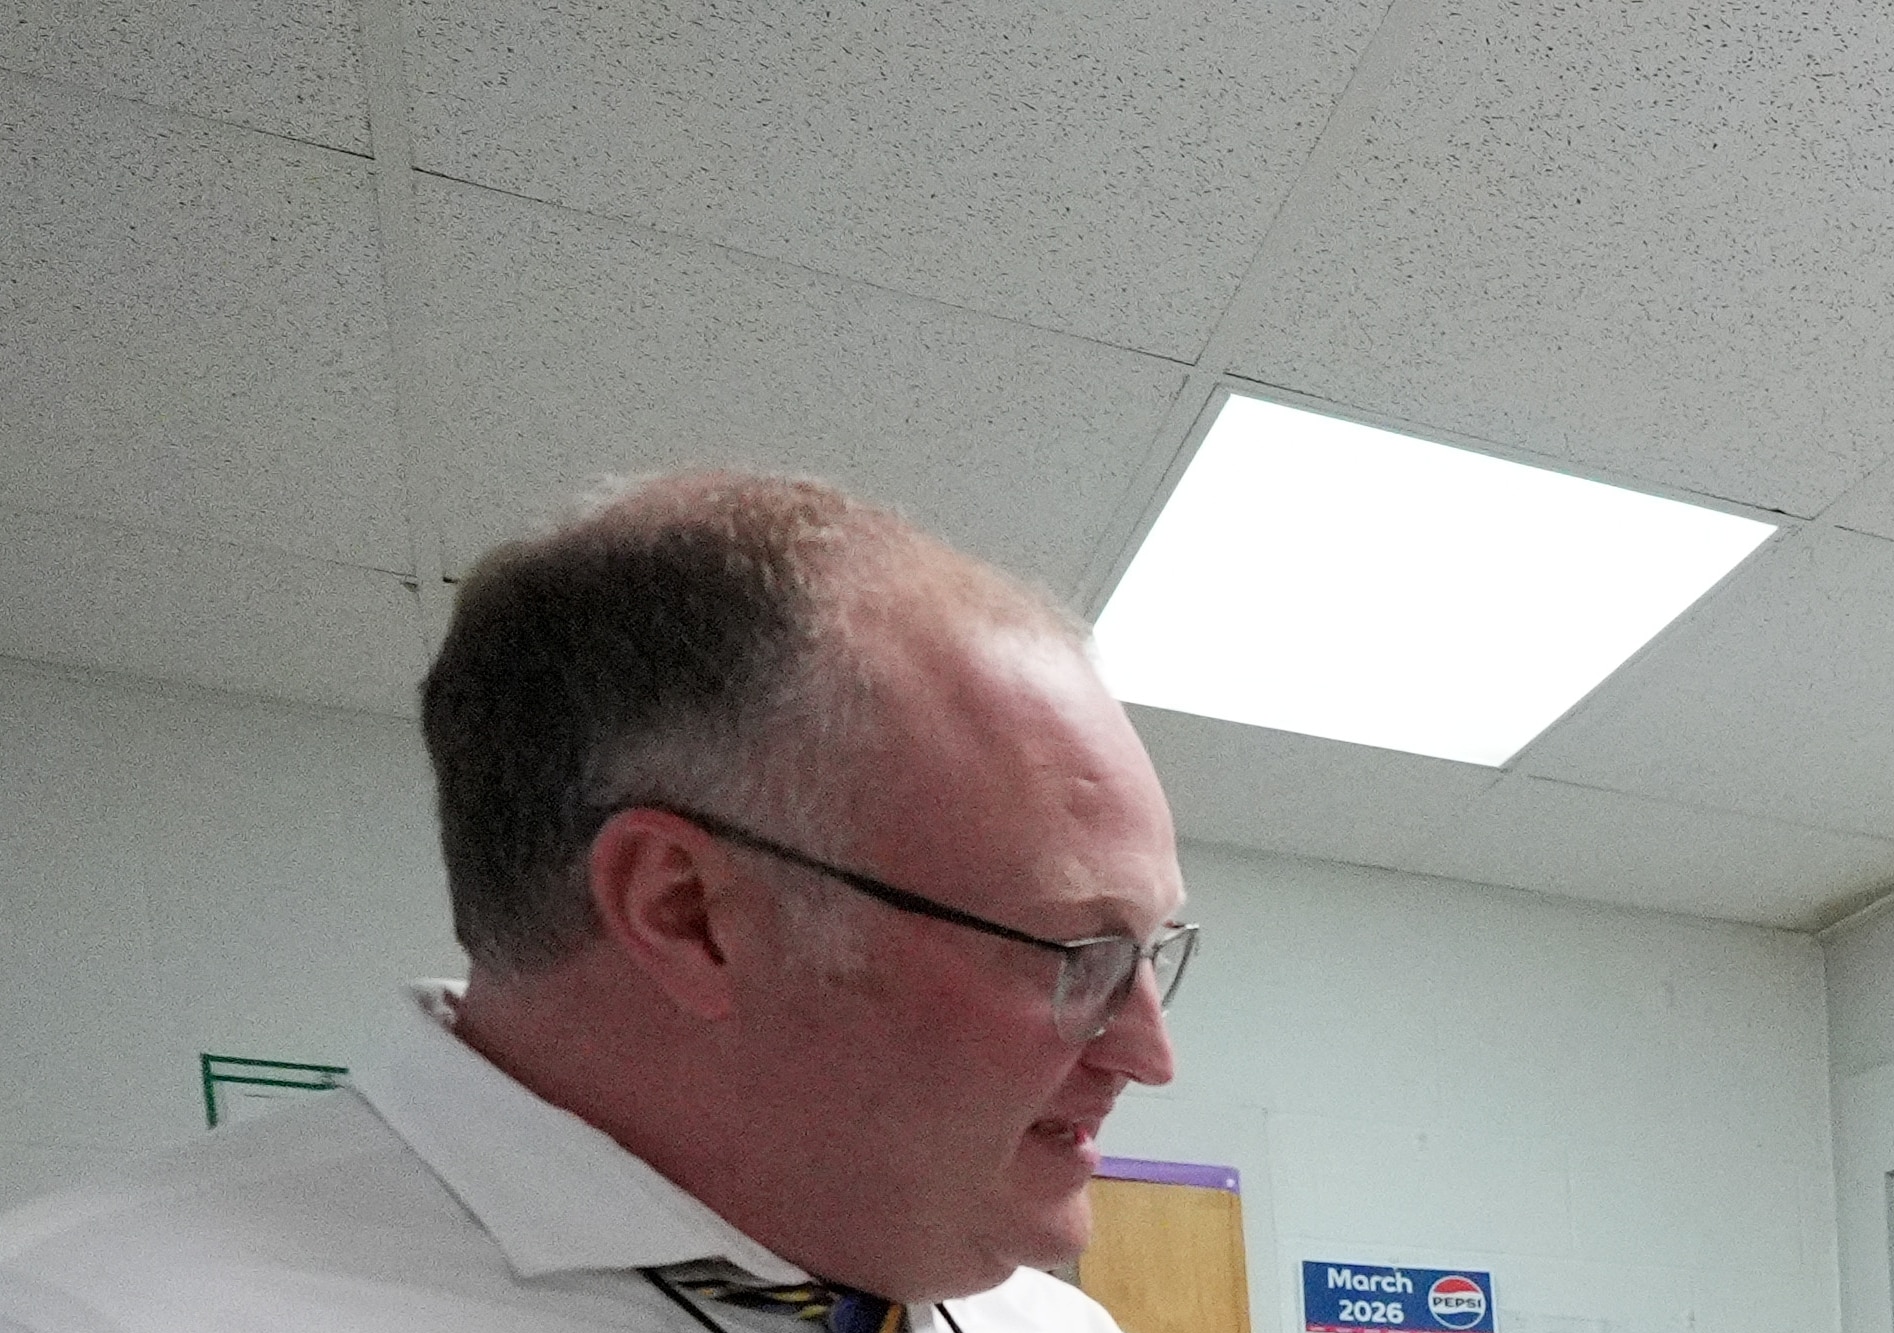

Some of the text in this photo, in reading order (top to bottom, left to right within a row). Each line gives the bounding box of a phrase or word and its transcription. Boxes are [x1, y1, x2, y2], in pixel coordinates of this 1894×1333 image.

[1327, 1267, 1413, 1294] March
[1339, 1300, 1404, 1324] 2026
[1433, 1297, 1481, 1309] PEPSI
